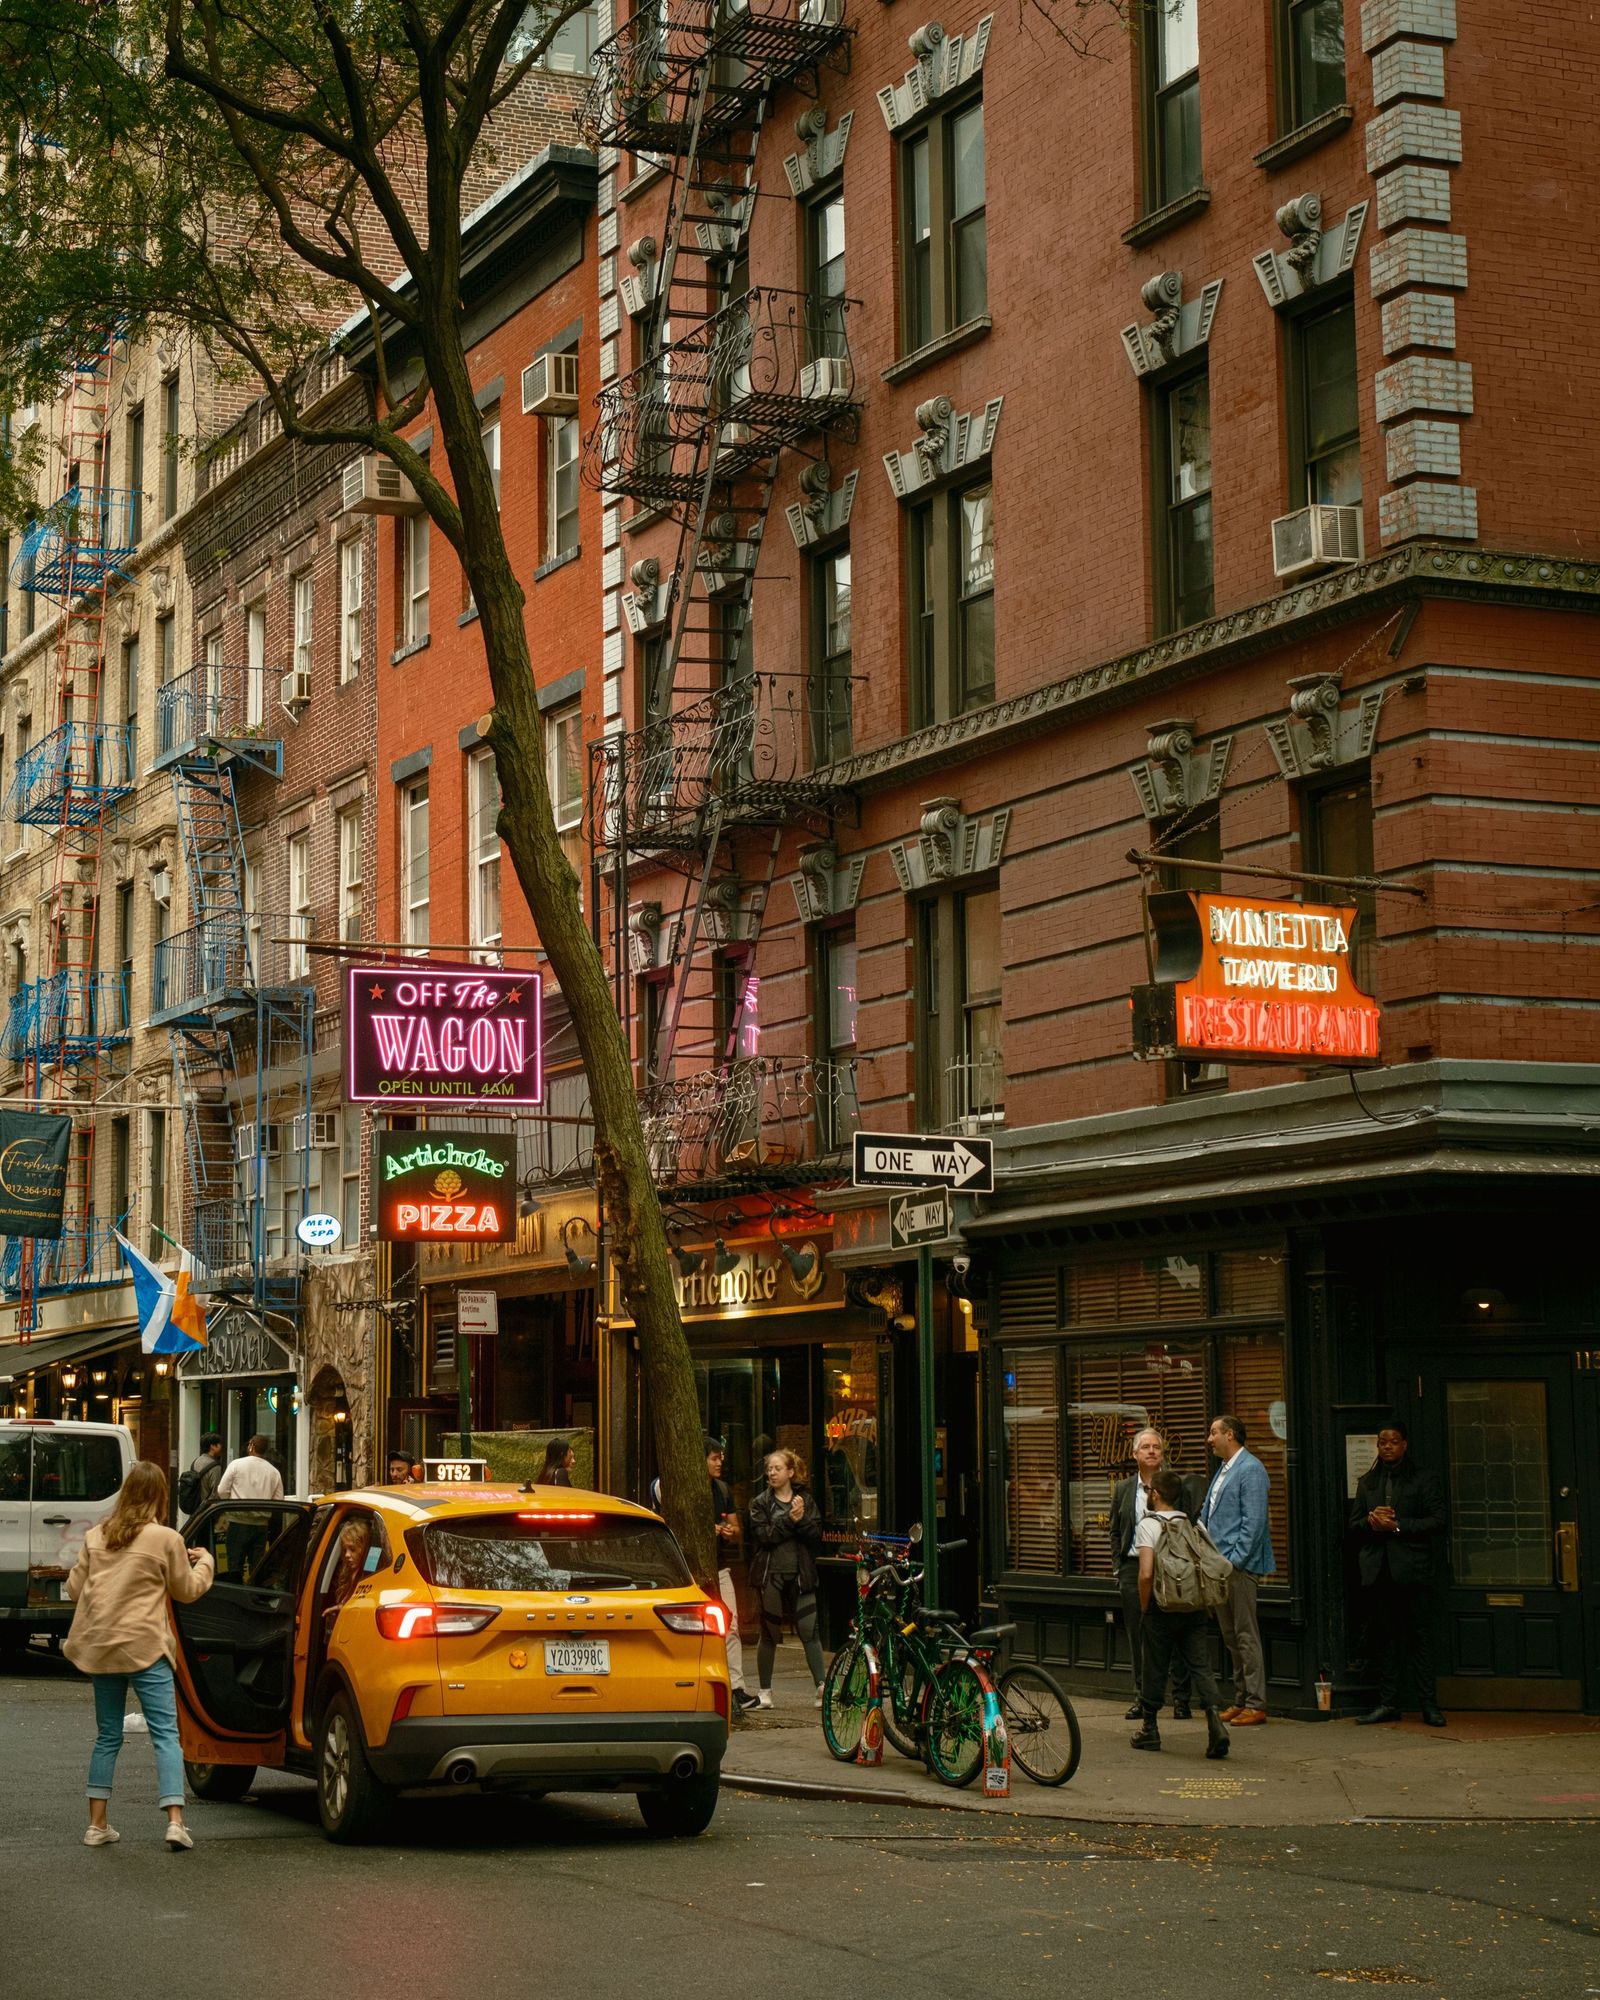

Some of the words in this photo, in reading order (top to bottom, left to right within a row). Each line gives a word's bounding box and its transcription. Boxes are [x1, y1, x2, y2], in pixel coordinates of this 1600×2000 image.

[1209, 905, 1349, 954] MINETTA
[1219, 956, 1338, 993] TAVERN
[395, 981, 448, 1007] OFF
[453, 979, 500, 1009] The
[1182, 994, 1381, 1054] RESTAURANT
[371, 1014, 527, 1074] WAGON
[378, 1080, 424, 1095] OPEN
[429, 1081, 476, 1096] UNTIL
[480, 1081, 515, 1097] 4AM
[5, 1149, 66, 1173] Freshman
[384, 1142, 505, 1181] Artichoke
[875, 1150, 914, 1172] ONE
[931, 1153, 972, 1174] WAY
[6, 1184, 62, 1198] 917-364-9128
[306, 1218, 333, 1227] MEN
[396, 1203, 500, 1232] PIZZA
[899, 1210, 915, 1231] ONE
[924, 1204, 942, 1226] WAY
[310, 1229, 334, 1237] SPA
[468, 1296, 488, 1304] PARKING
[827, 1408, 878, 1451] PIZZA
[437, 1464, 472, 1482] 9T52
[550, 1649, 604, 1666] Y203998C
